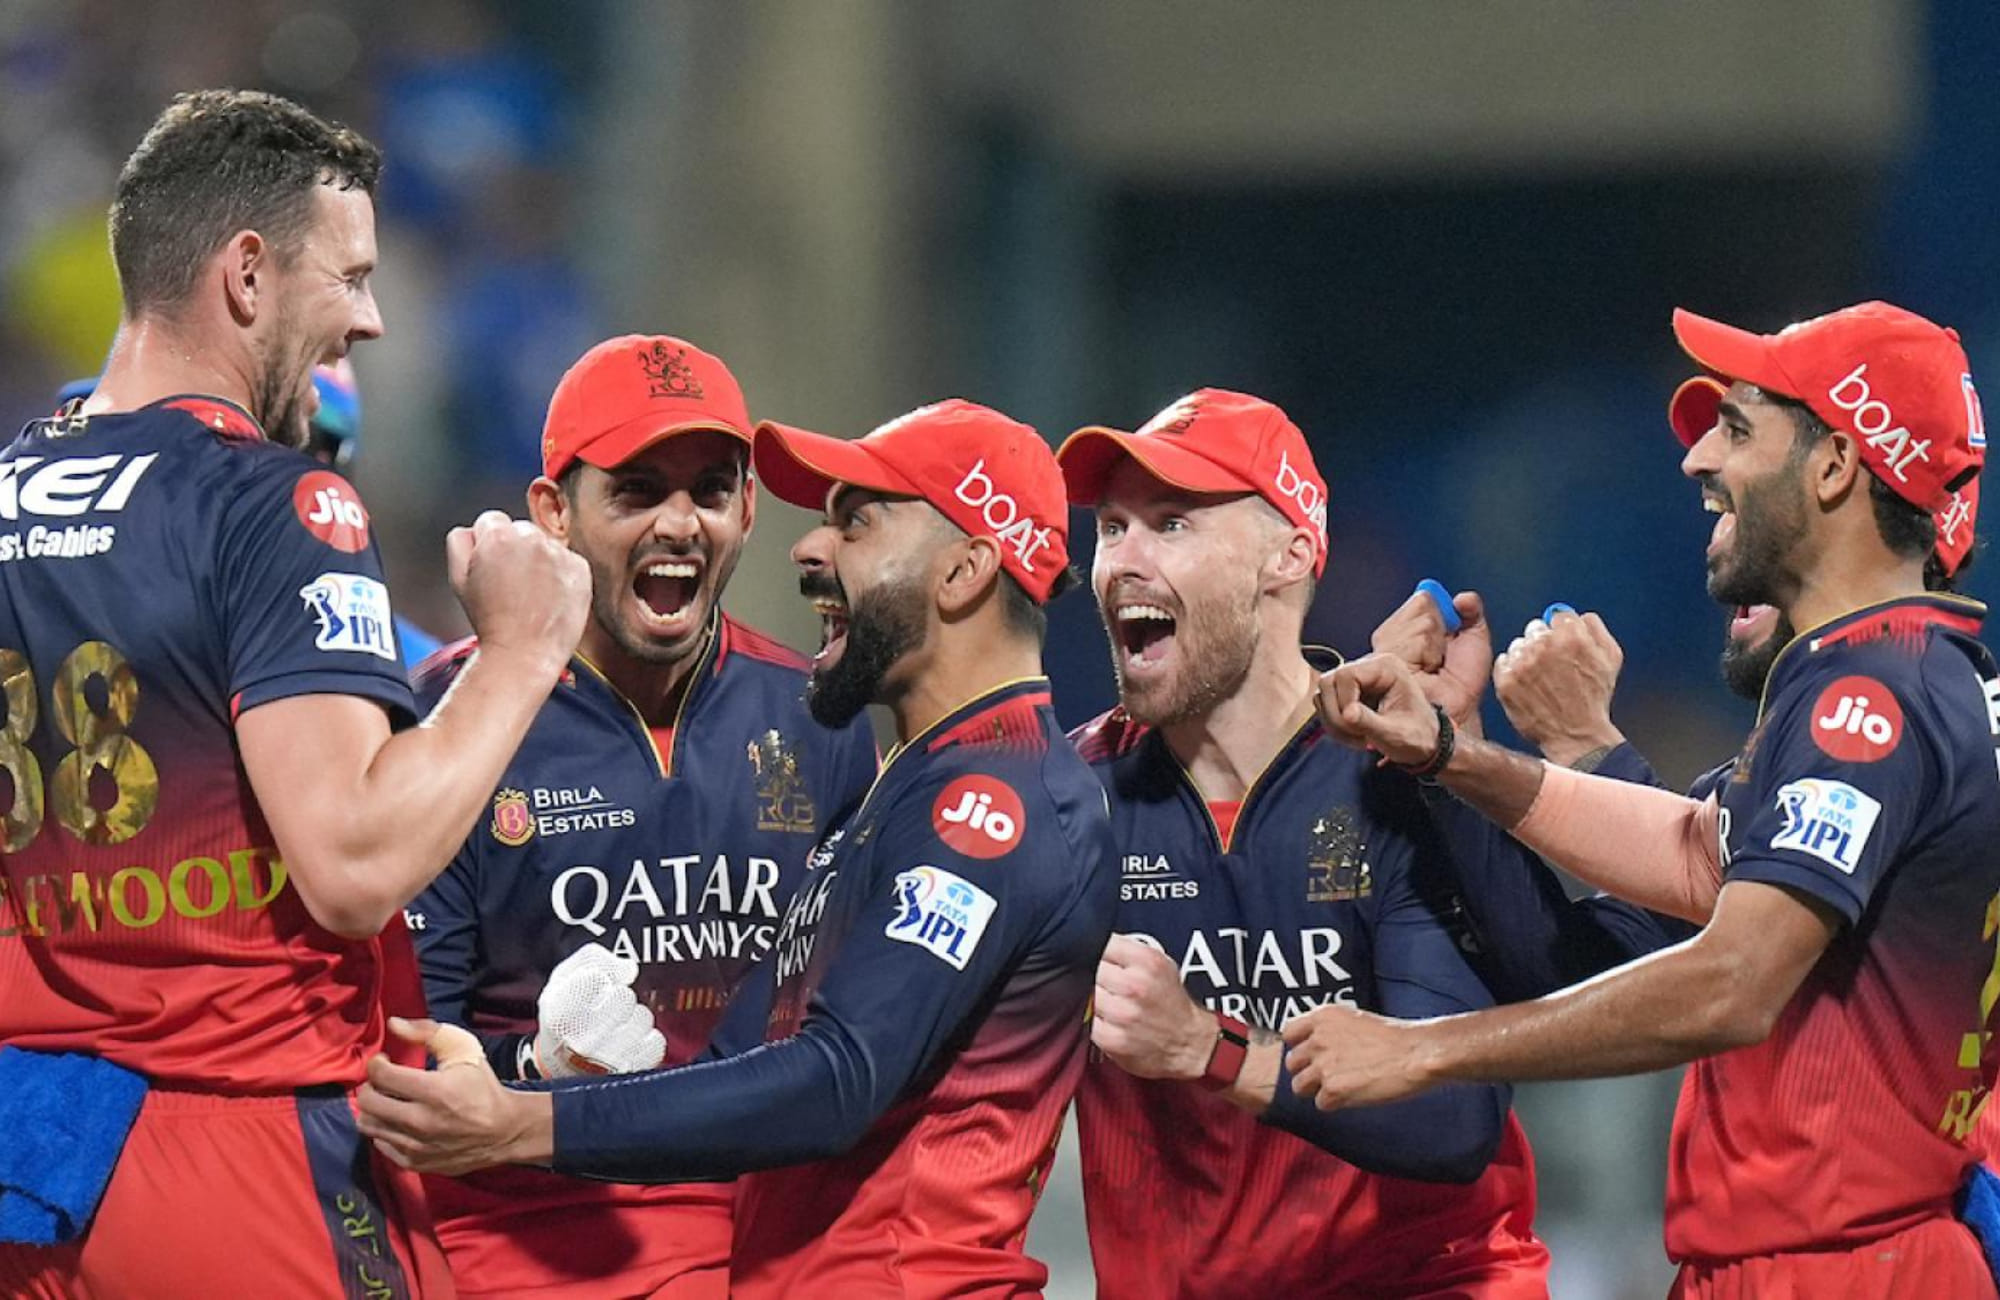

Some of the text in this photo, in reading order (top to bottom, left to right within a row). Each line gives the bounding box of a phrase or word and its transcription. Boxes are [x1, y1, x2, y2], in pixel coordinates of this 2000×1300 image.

[1829, 363, 1932, 484] boAt
[309, 487, 365, 529] Jio
[954, 459, 1052, 573] boAt
[26, 524, 116, 558] Cables
[349, 616, 391, 652] IPL
[1819, 696, 1893, 745] Jio
[533, 786, 604, 808] BIRLA
[941, 791, 1016, 842] Jio
[538, 809, 636, 837] ESTATES
[1800, 818, 1852, 866] IPL
[1121, 855, 1171, 873] IRLA
[551, 854, 780, 937] QATAR
[1120, 881, 1199, 901] STATES
[917, 911, 967, 962] IPL
[1115, 927, 1352, 989] ATAR
